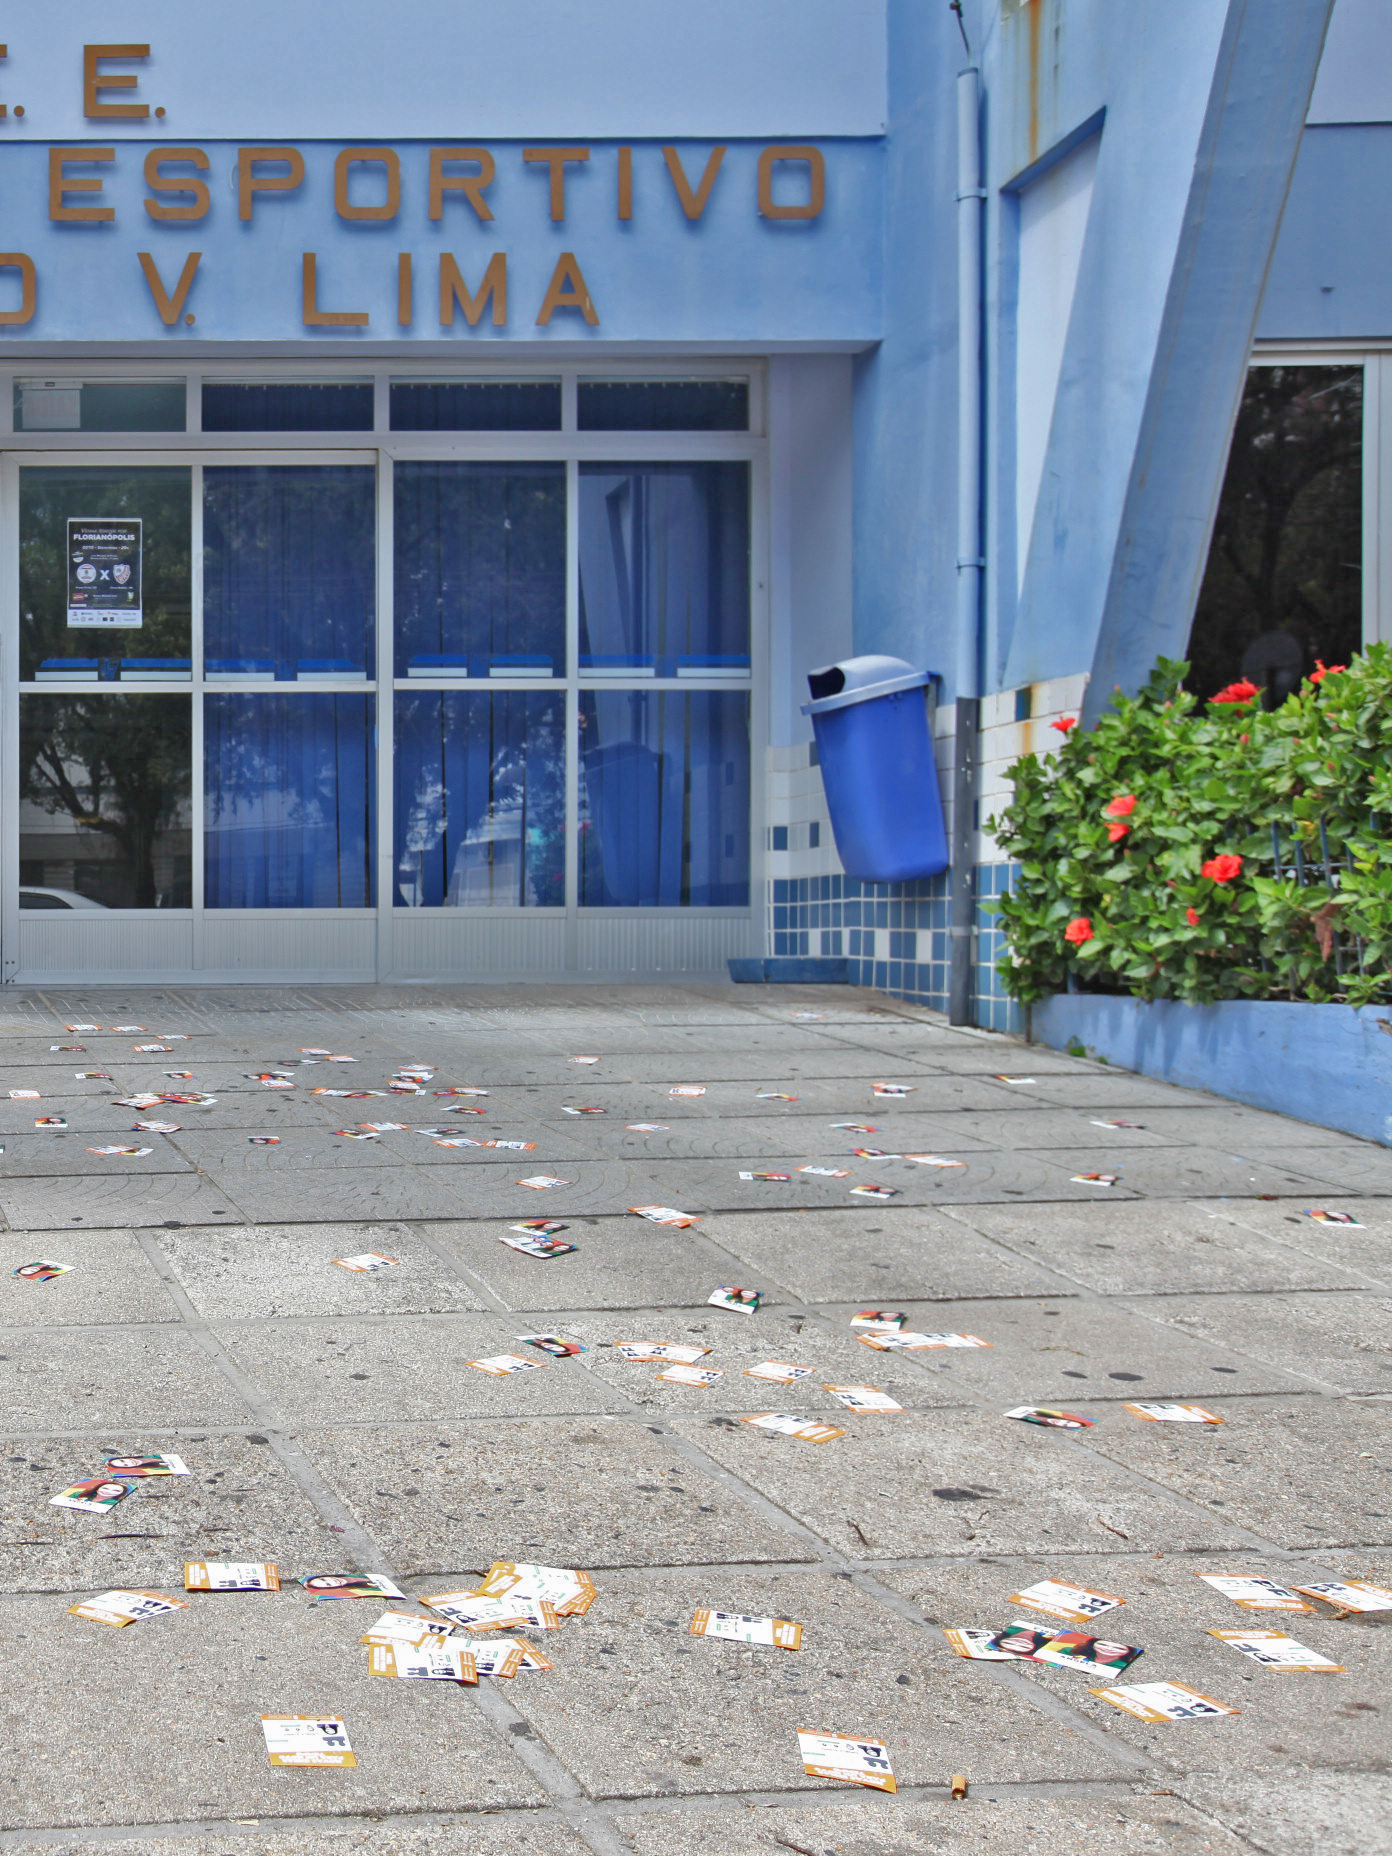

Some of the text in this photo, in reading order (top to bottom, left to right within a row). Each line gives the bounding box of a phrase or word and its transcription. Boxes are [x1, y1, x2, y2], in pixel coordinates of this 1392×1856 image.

[49, 146, 825, 221] ESPORTIVO
[137, 252, 201, 325] V.
[302, 252, 600, 326] LIMA
[73, 533, 135, 541] FLORIANÓPOLIS
